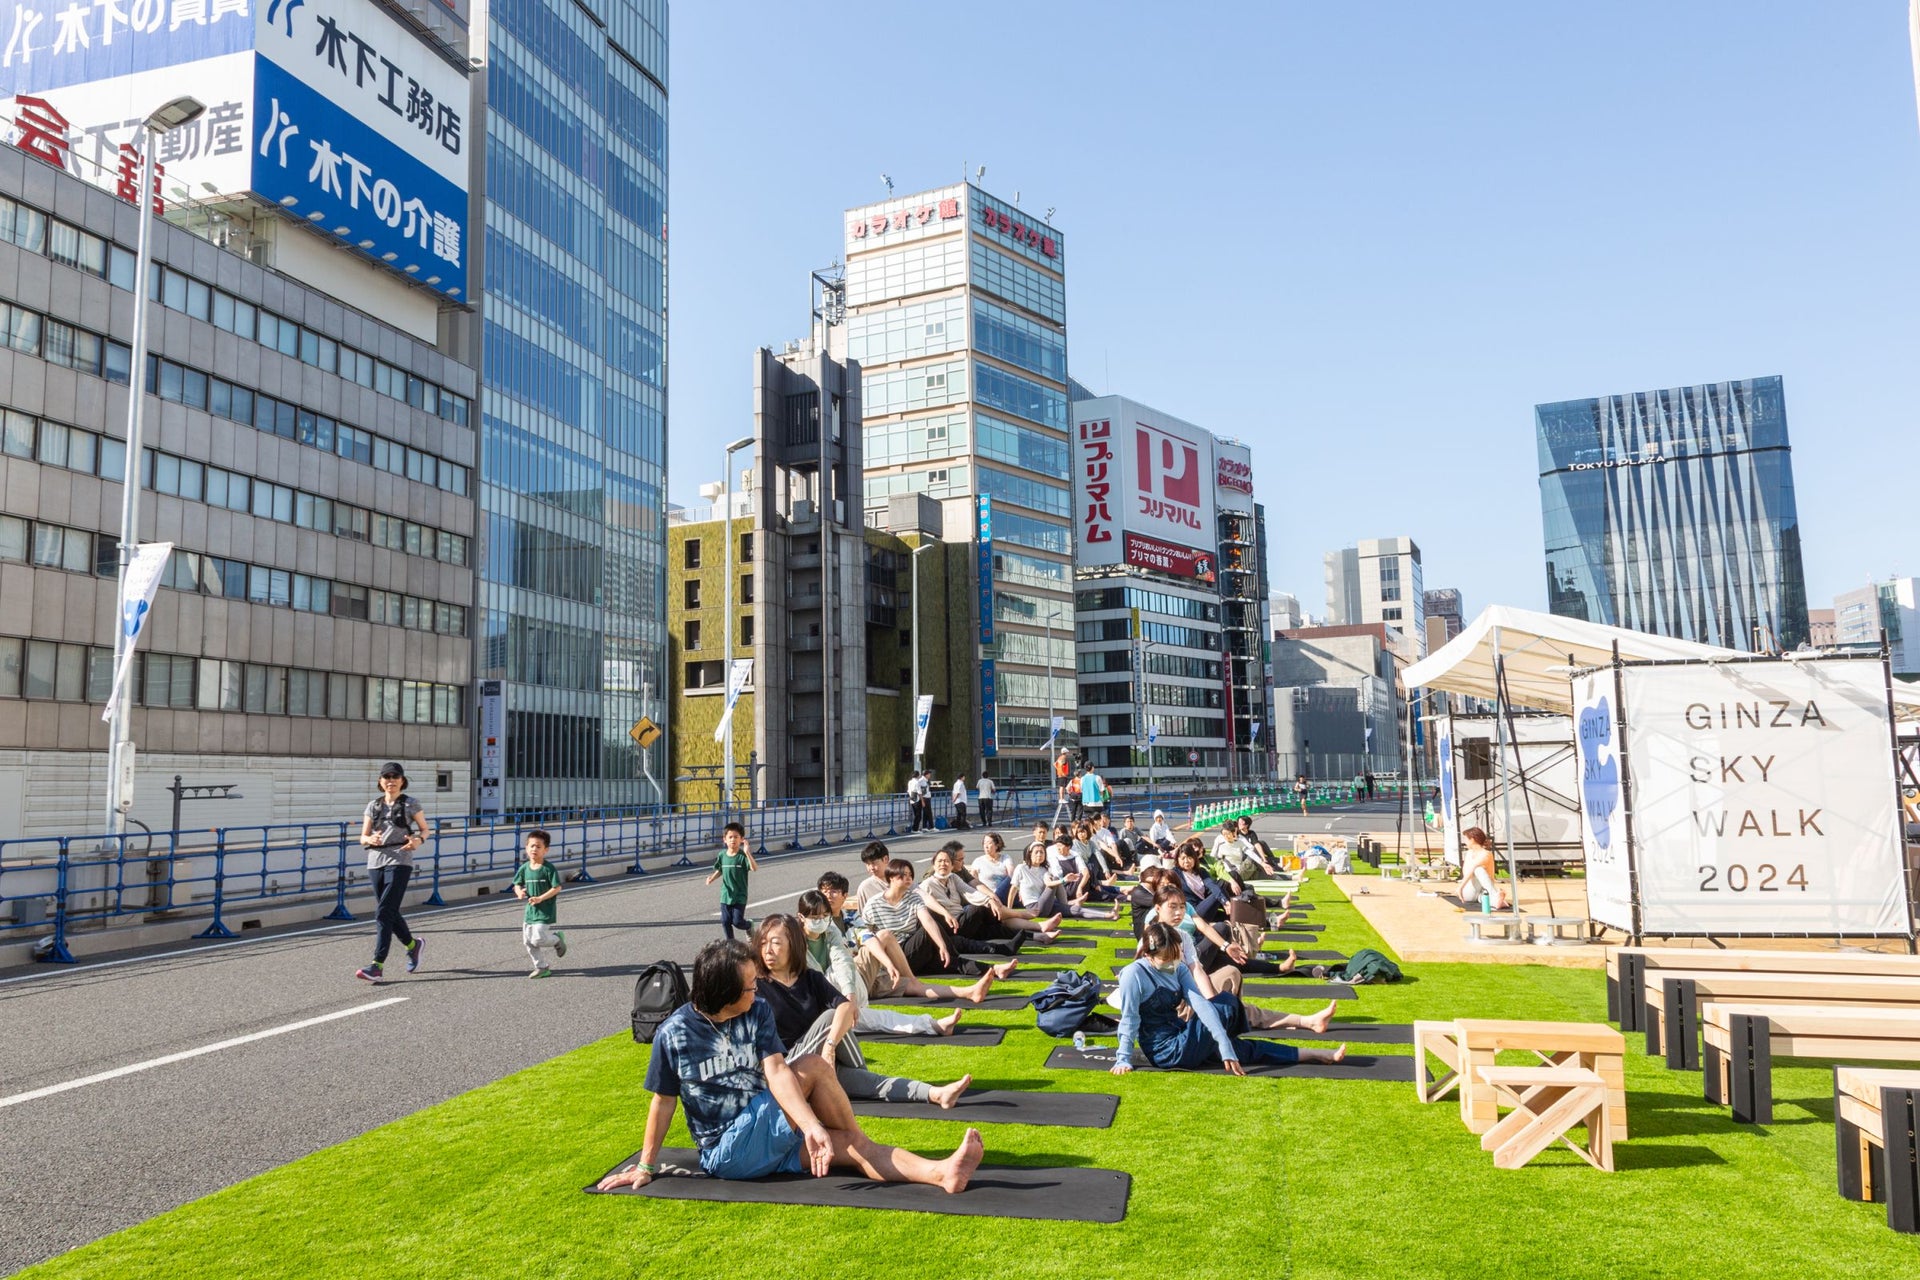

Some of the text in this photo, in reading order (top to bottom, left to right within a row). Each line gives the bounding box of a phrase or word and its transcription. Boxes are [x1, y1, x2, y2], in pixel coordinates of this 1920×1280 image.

[315, 14, 461, 155] 木下工務店
[309, 140, 461, 269] 木下の介護
[852, 198, 960, 239] カラオケ館
[984, 206, 1057, 259] カラオケ館
[1567, 455, 1665, 471] TOKYU PLAZA
[1084, 442, 1113, 543] プリマハム
[1138, 496, 1201, 530] プリマハム
[1582, 716, 1611, 741] GINZA
[1685, 700, 1827, 730] GINZA
[1690, 755, 1776, 784] SKY
[1693, 808, 1825, 837] WALK
[1699, 863, 1809, 893] 2024
